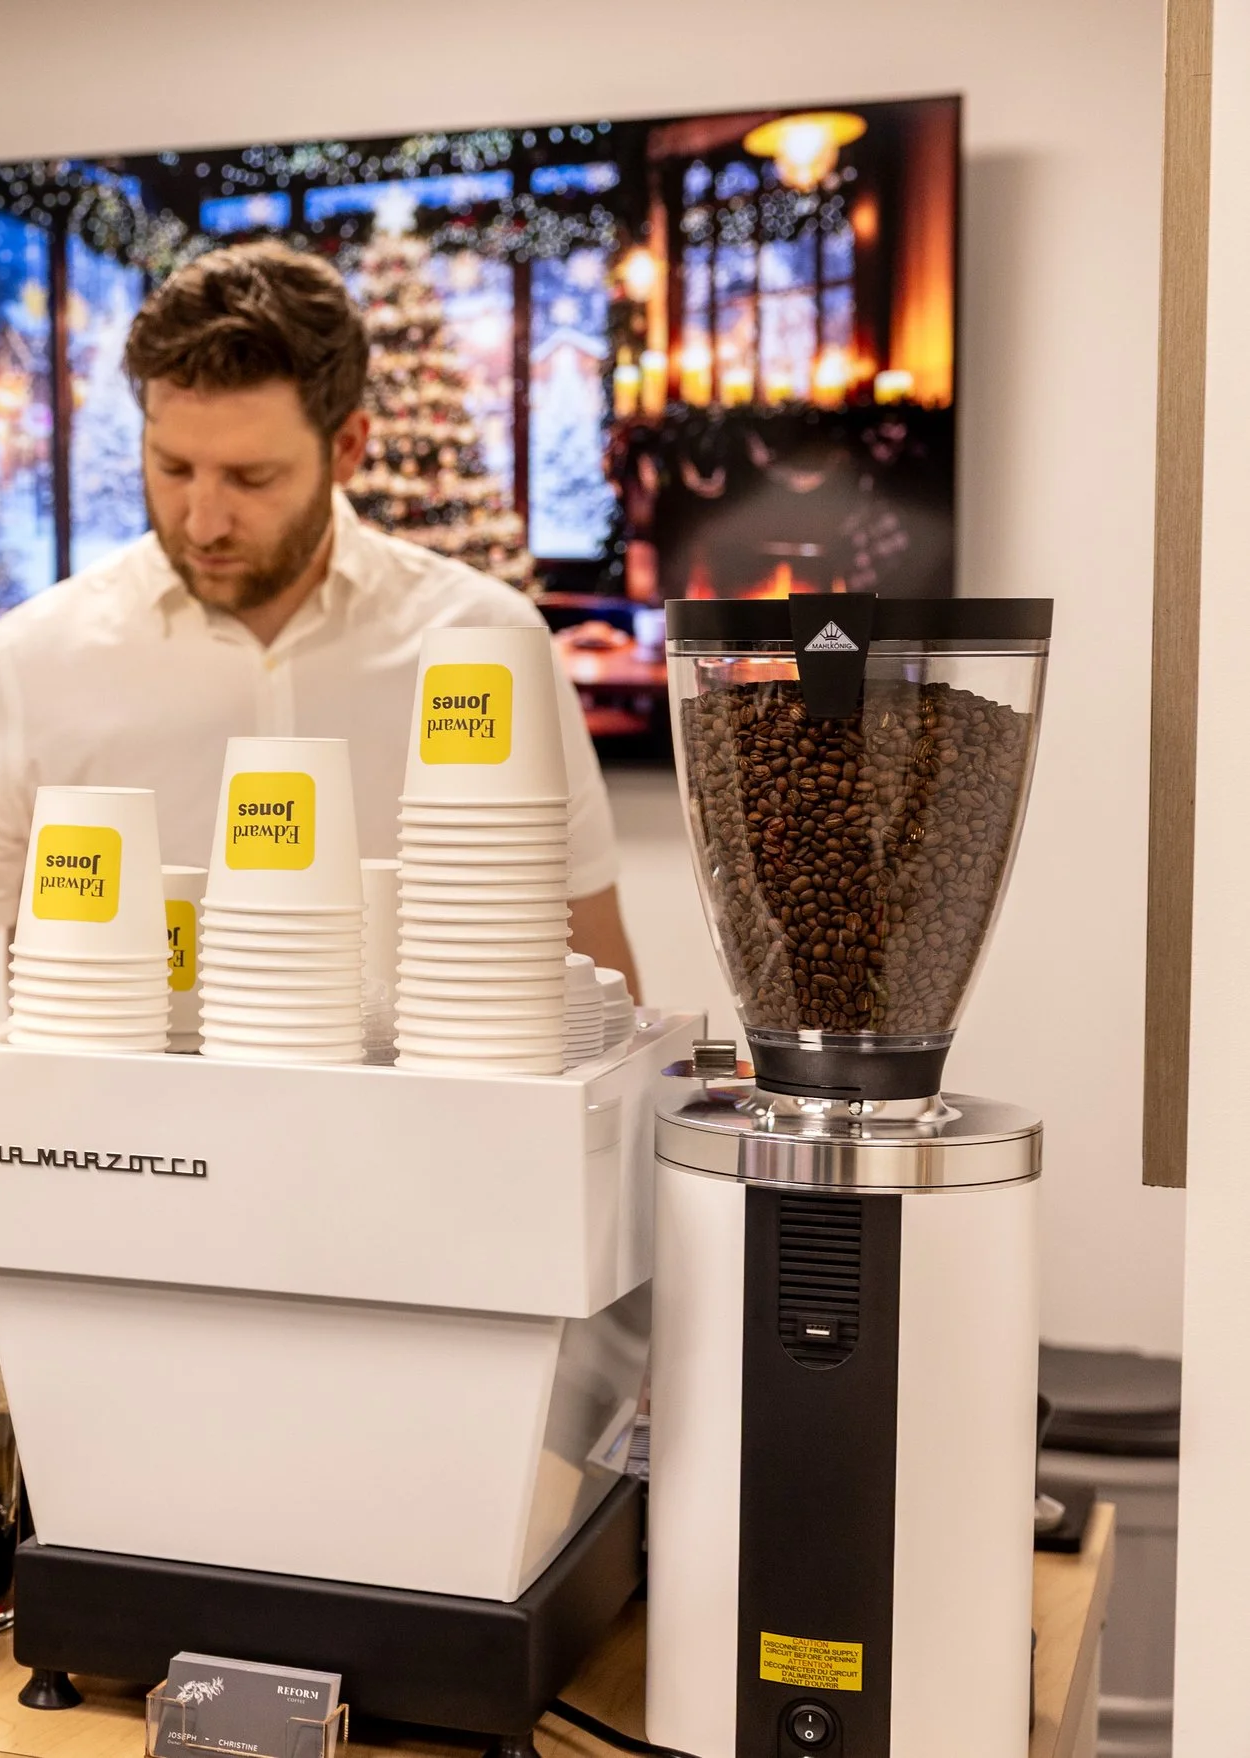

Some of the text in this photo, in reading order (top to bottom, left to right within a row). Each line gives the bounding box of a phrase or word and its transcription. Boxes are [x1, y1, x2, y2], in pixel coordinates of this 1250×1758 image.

[432, 693, 491, 715] Jones
[427, 718, 495, 739] Edward
[238, 800, 295, 822] Jones
[233, 824, 300, 845] Edward
[46, 854, 101, 875] Jones
[40, 876, 105, 898] Edward
[763, 1640, 859, 1657] DISCONNECT FROM SUPPLY
[793, 1638, 829, 1648] CAUTION
[765, 1647, 857, 1664] CIRCUIT BEFORE OPENING
[788, 1658, 833, 1669] ATTENTION
[781, 1670, 839, 1683] D'ALIMENTATION
[817, 1668, 828, 1676] DU
[830, 1670, 858, 1678] CIRCUIT
[781, 1677, 839, 1689] AVANT D'OUVRIR
[277, 1685, 319, 1700] REFORM
[168, 1731, 197, 1742] JOSEPH
[218, 1738, 258, 1752] CHRISTINE
